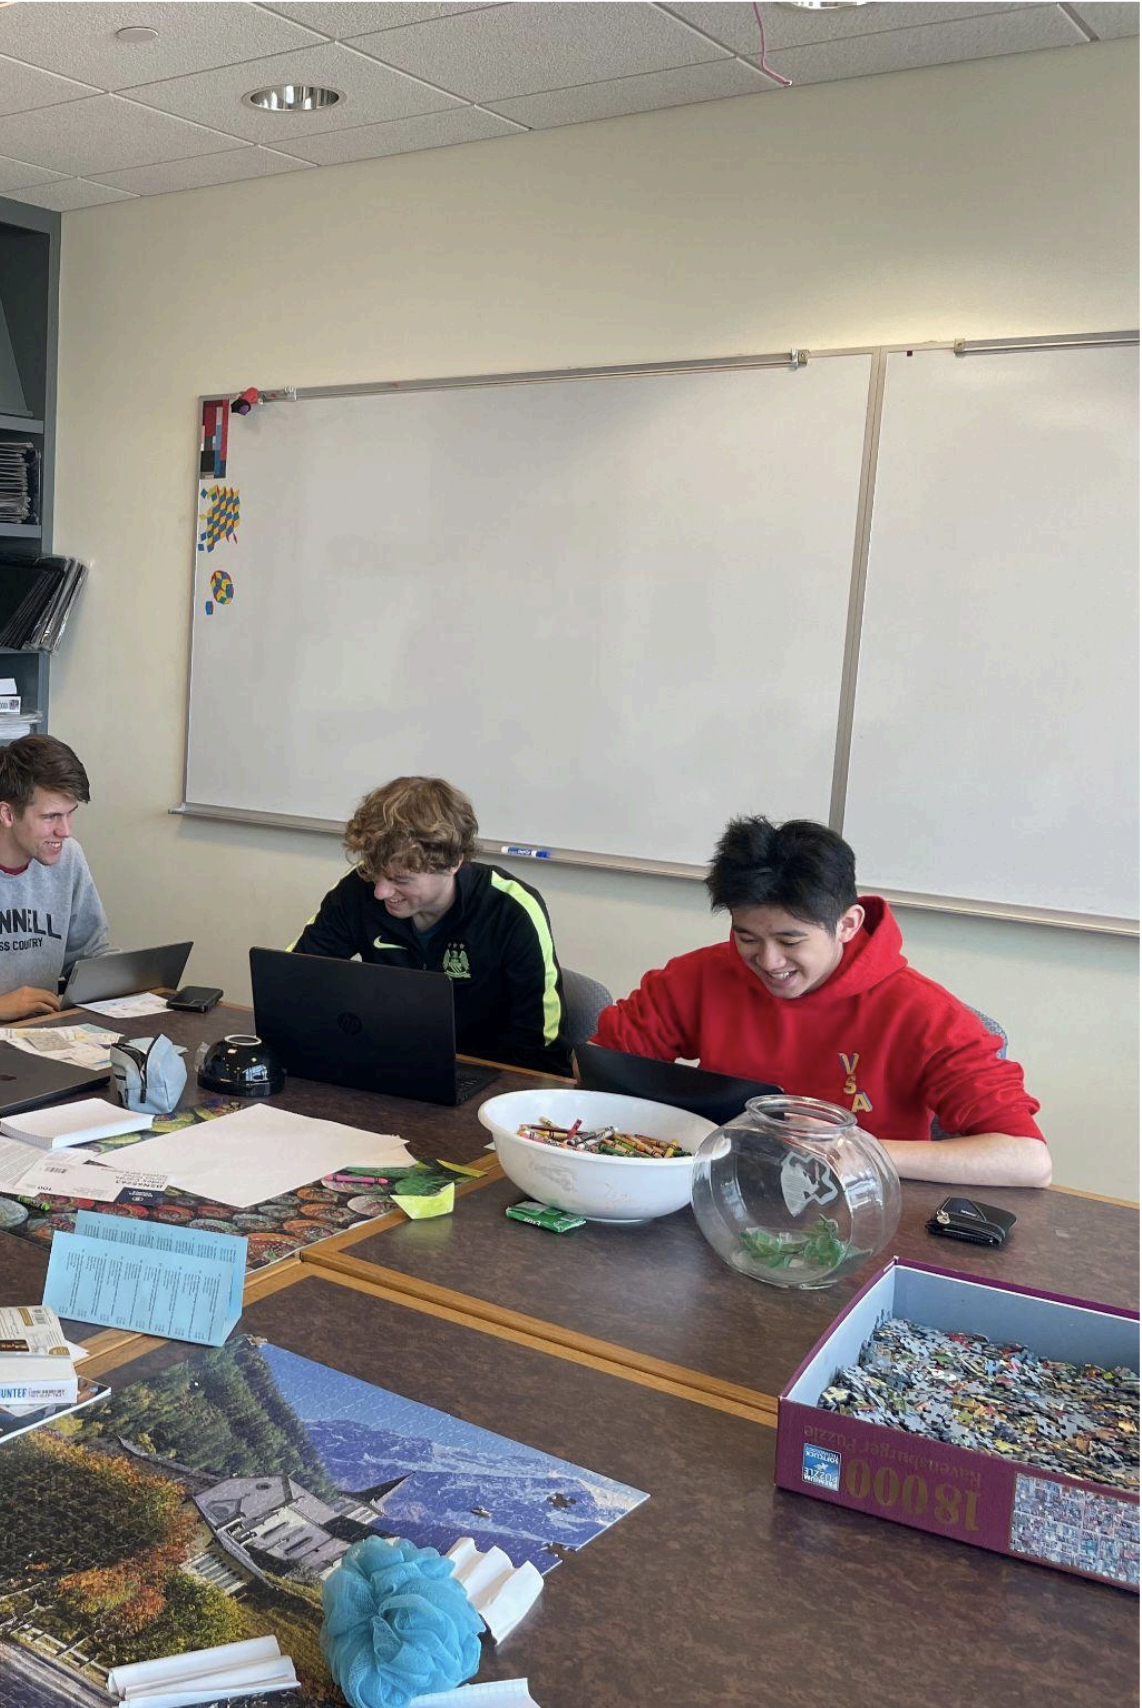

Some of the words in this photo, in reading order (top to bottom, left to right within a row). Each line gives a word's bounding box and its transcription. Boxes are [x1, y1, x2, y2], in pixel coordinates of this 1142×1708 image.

[803, 1424, 857, 1452] Puzzle
[803, 1467, 838, 1483] PUZZLE
[862, 1441, 982, 1488] Ravensburger
